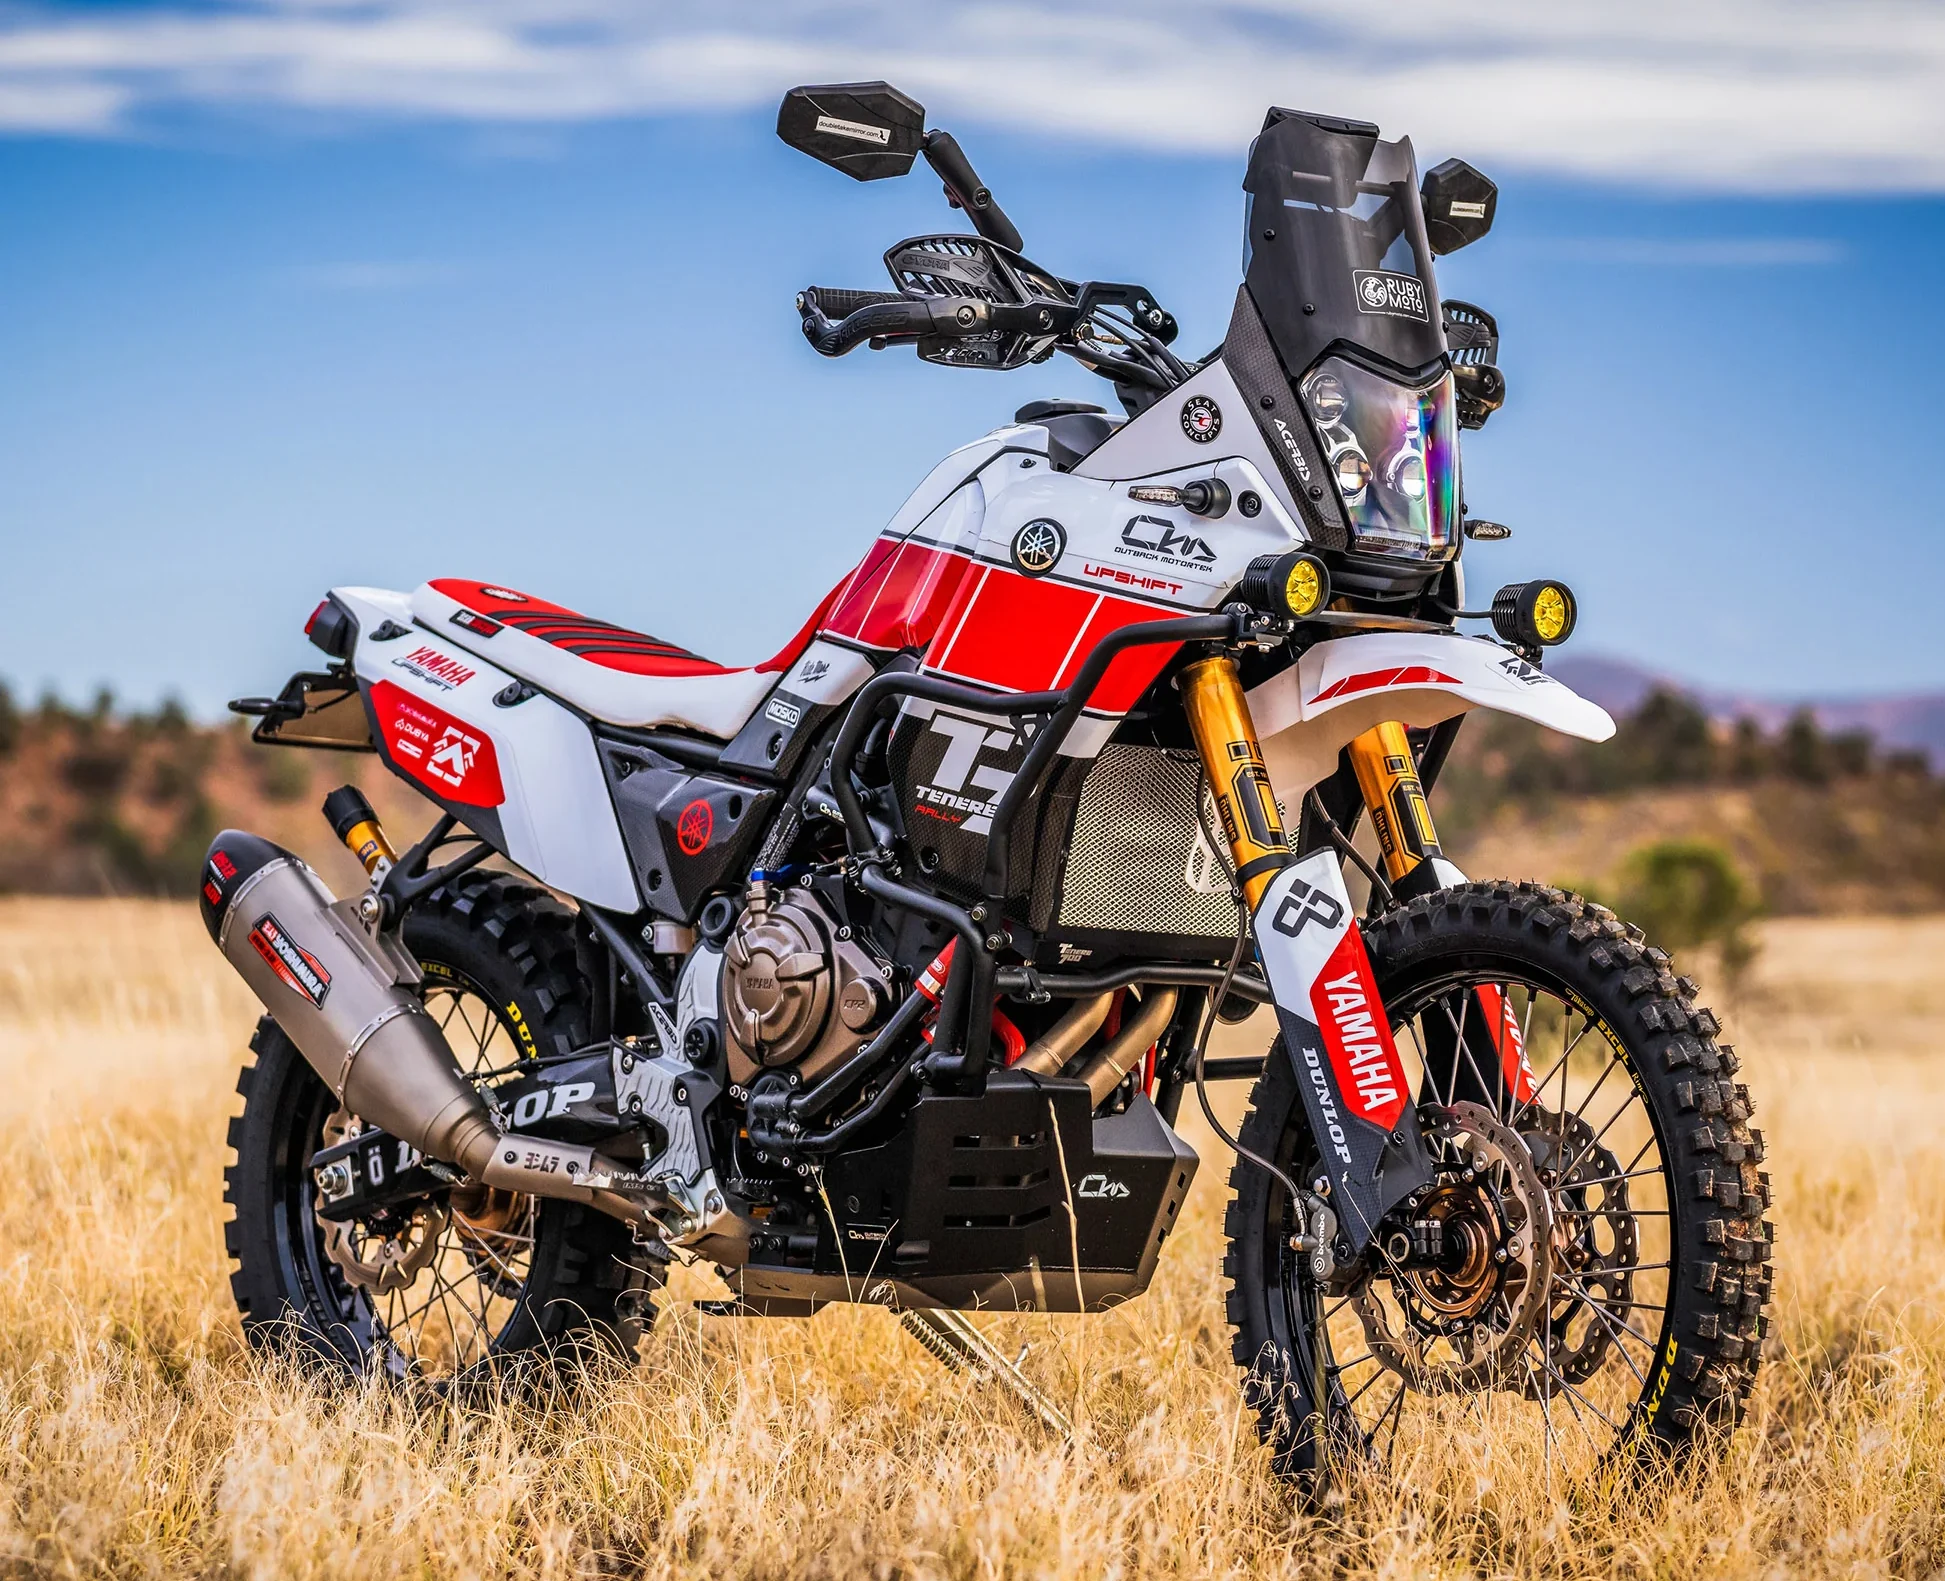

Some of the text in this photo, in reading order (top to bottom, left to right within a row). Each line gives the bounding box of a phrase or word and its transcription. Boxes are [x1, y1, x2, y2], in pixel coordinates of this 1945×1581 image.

[818, 120, 880, 138] doubletakemirror.com
[1385, 278, 1421, 299] RUBY
[1187, 398, 1218, 411] SEAT
[1182, 413, 1220, 441] CONCEPTS
[1114, 546, 1213, 573] OUTBACK MOTORTEK
[1083, 563, 1184, 595] UPSHIFT
[406, 646, 476, 687] YAMAHA
[768, 702, 798, 723] MOSKO
[914, 804, 962, 823] RALLY
[272, 933, 324, 999] YOSHIMURA
[1324, 970, 1399, 1111] YAMAHA
[1597, 1018, 1629, 1066] EXCEL
[1303, 1047, 1352, 1164] DUNLOP
[1317, 1213, 1326, 1255] brembo
